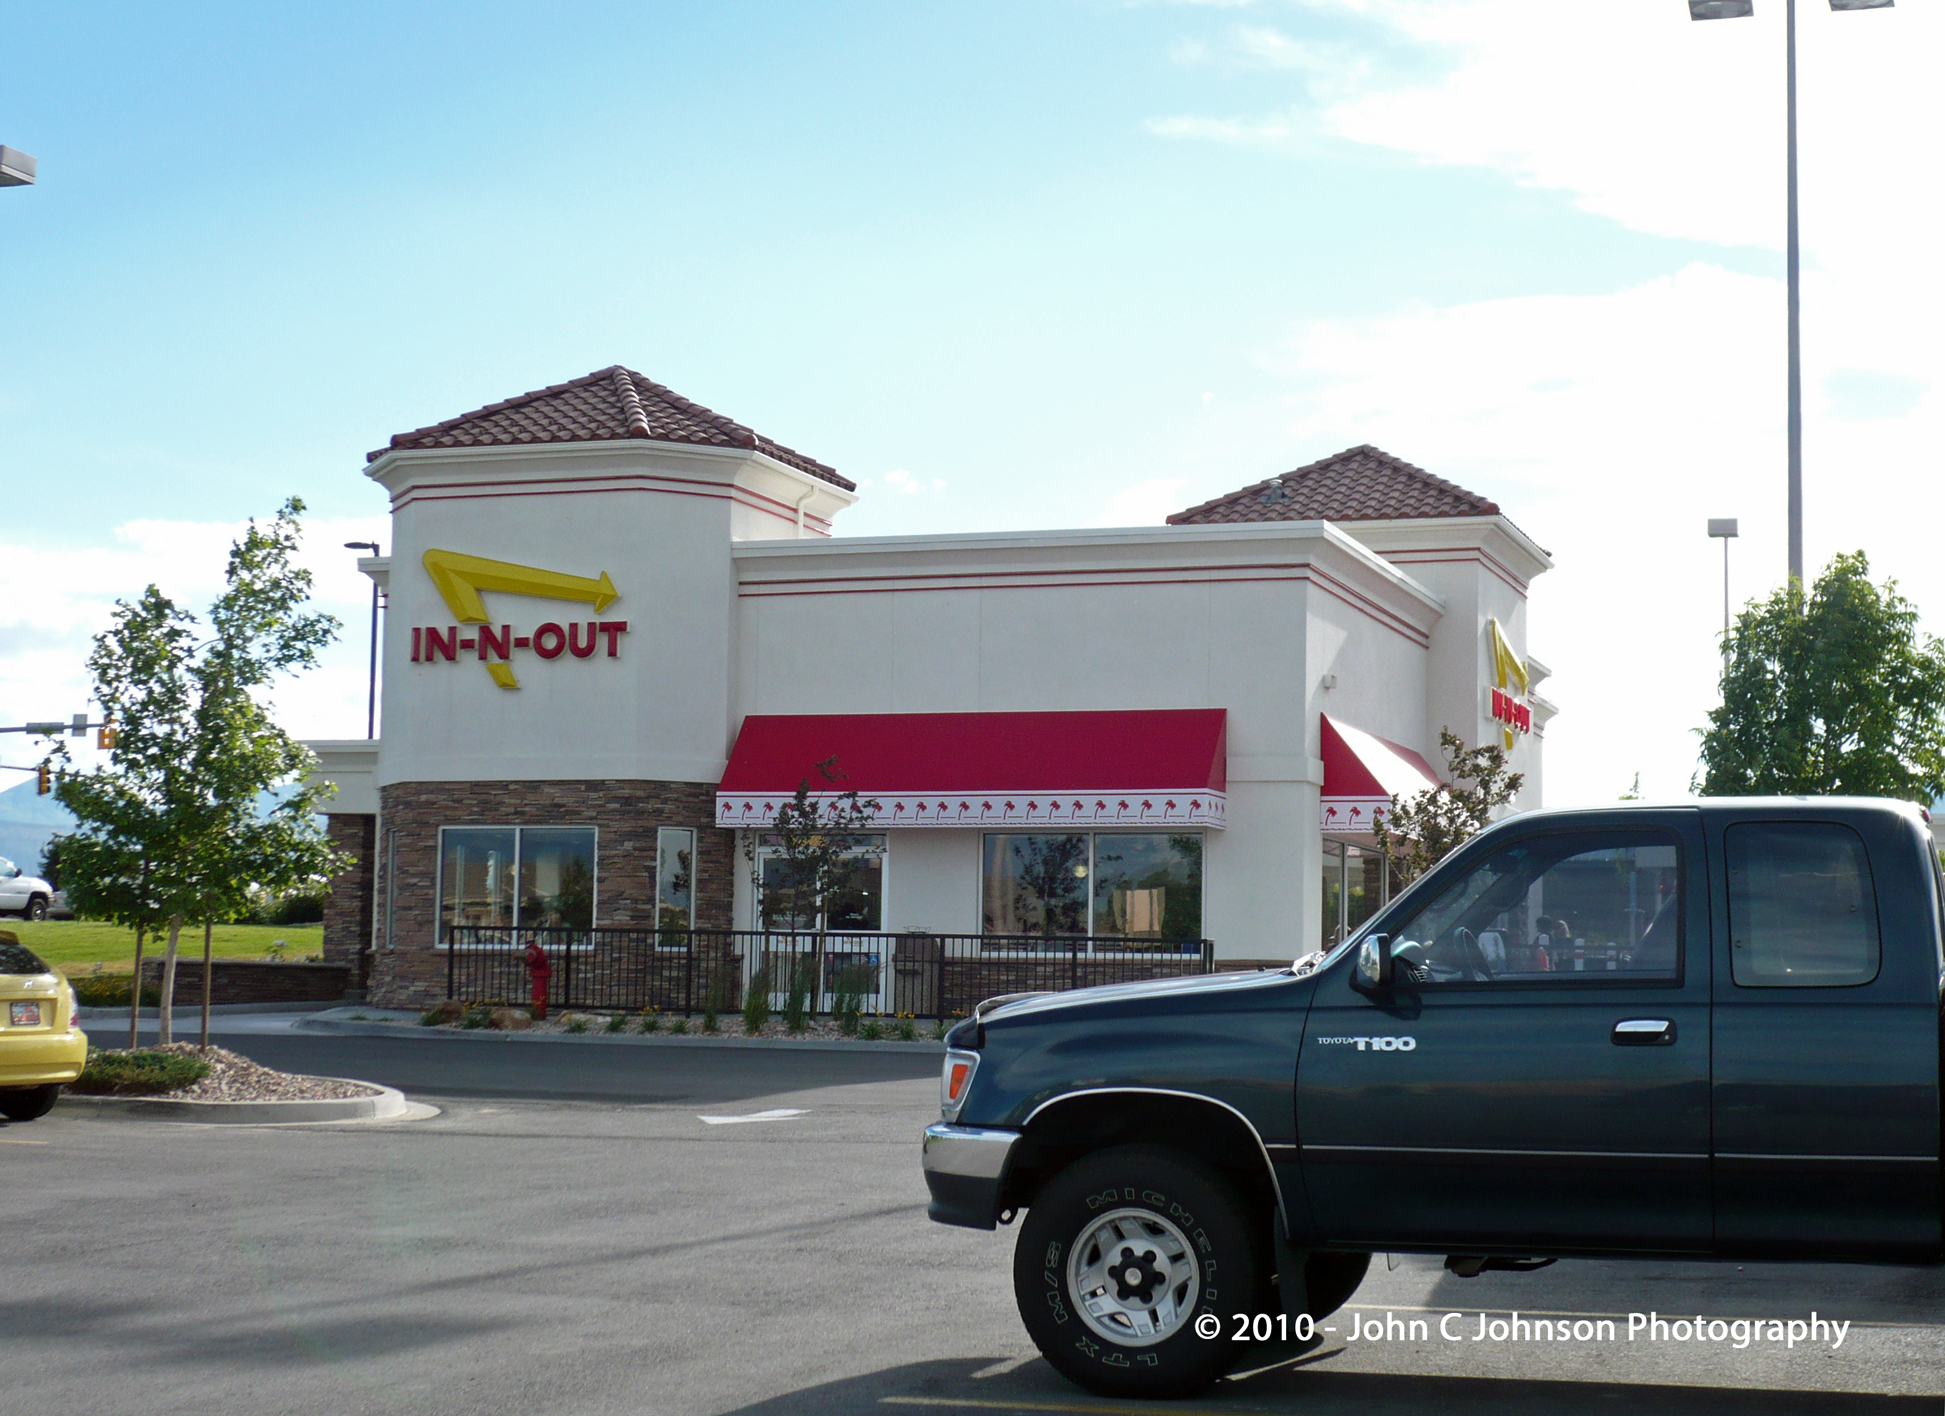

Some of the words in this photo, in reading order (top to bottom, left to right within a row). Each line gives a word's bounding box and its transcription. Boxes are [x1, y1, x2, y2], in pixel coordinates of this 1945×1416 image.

[411, 621, 629, 662] IN-N-OUT
[1317, 1036, 1353, 1045] TOYOTA
[1352, 1036, 1417, 1052] T100
[1044, 1241, 1069, 1324] M/S
[1075, 1336, 1159, 1367] LTX
